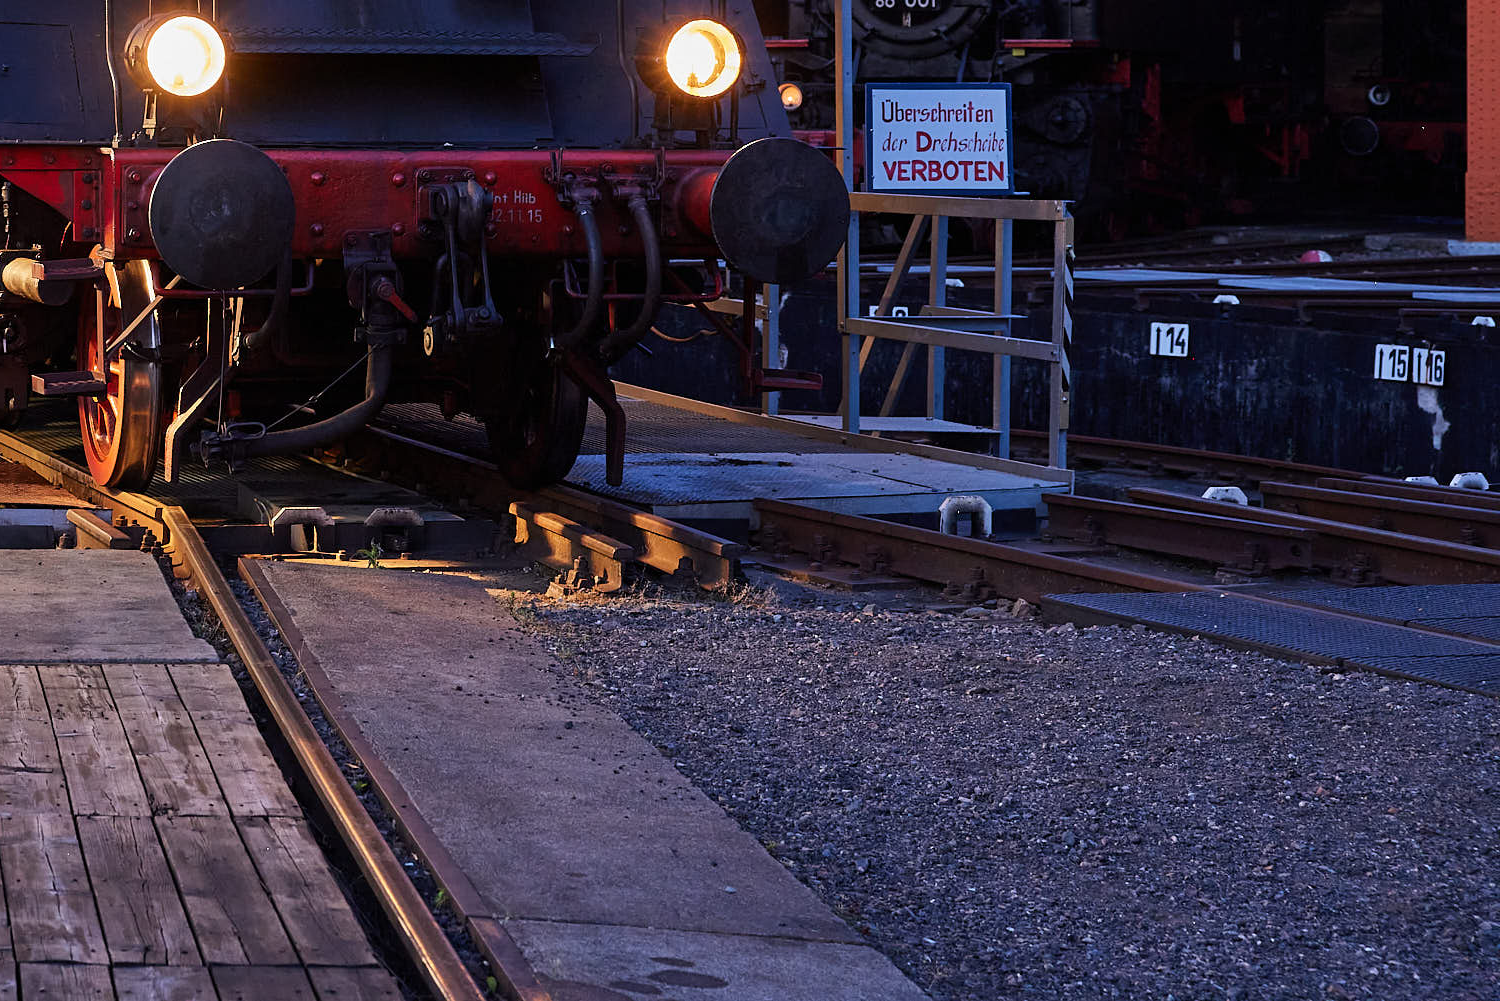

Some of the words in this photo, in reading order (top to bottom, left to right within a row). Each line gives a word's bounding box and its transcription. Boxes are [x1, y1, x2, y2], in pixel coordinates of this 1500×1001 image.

[881, 99, 994, 123] Überschreiten
[882, 131, 907, 152] der
[916, 131, 1005, 152] Drehscheibe
[882, 160, 1005, 182] VERBOTEN
[491, 189, 508, 204] nt
[514, 189, 536, 205] Hilb
[1166, 327, 1186, 355] 14
[1389, 348, 1407, 378] 15
[1428, 353, 1443, 383] 16
